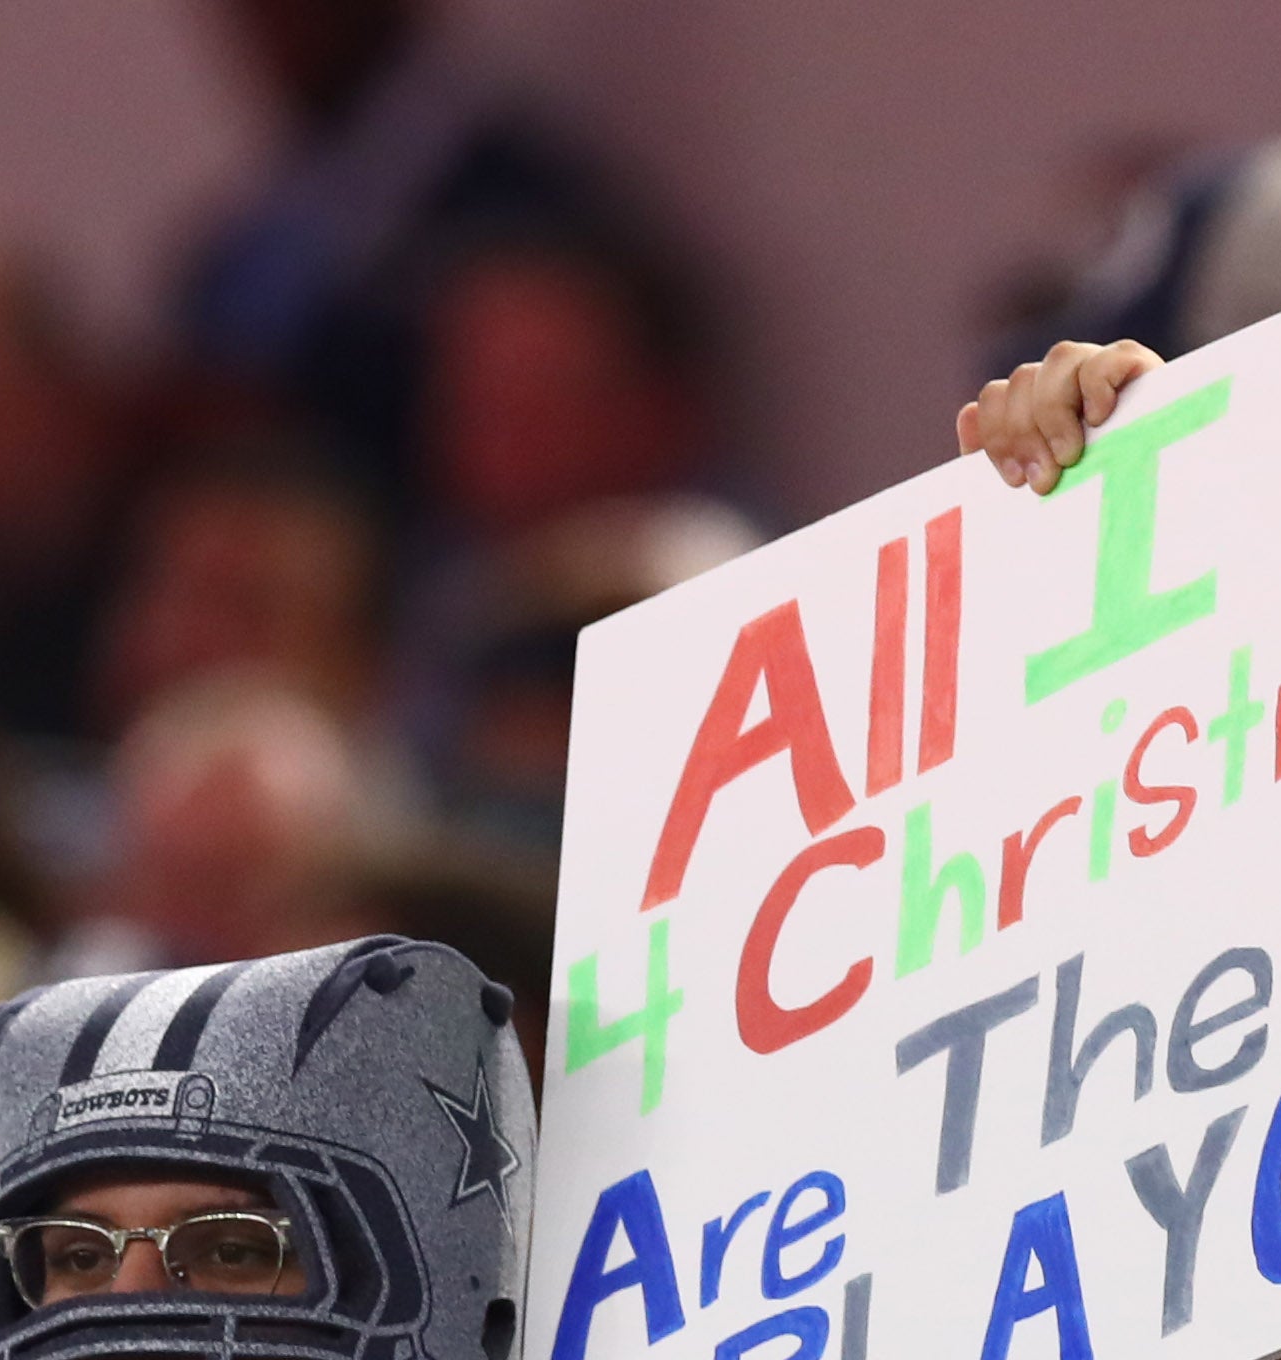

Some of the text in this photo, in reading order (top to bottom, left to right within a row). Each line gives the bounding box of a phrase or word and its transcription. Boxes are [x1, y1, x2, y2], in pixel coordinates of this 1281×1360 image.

[641, 507, 962, 911] All
[1024, 376, 1232, 706] I
[63, 1088, 169, 1118] COWBOYS
[564, 919, 683, 1117] 4
[895, 947, 1274, 1194] The
